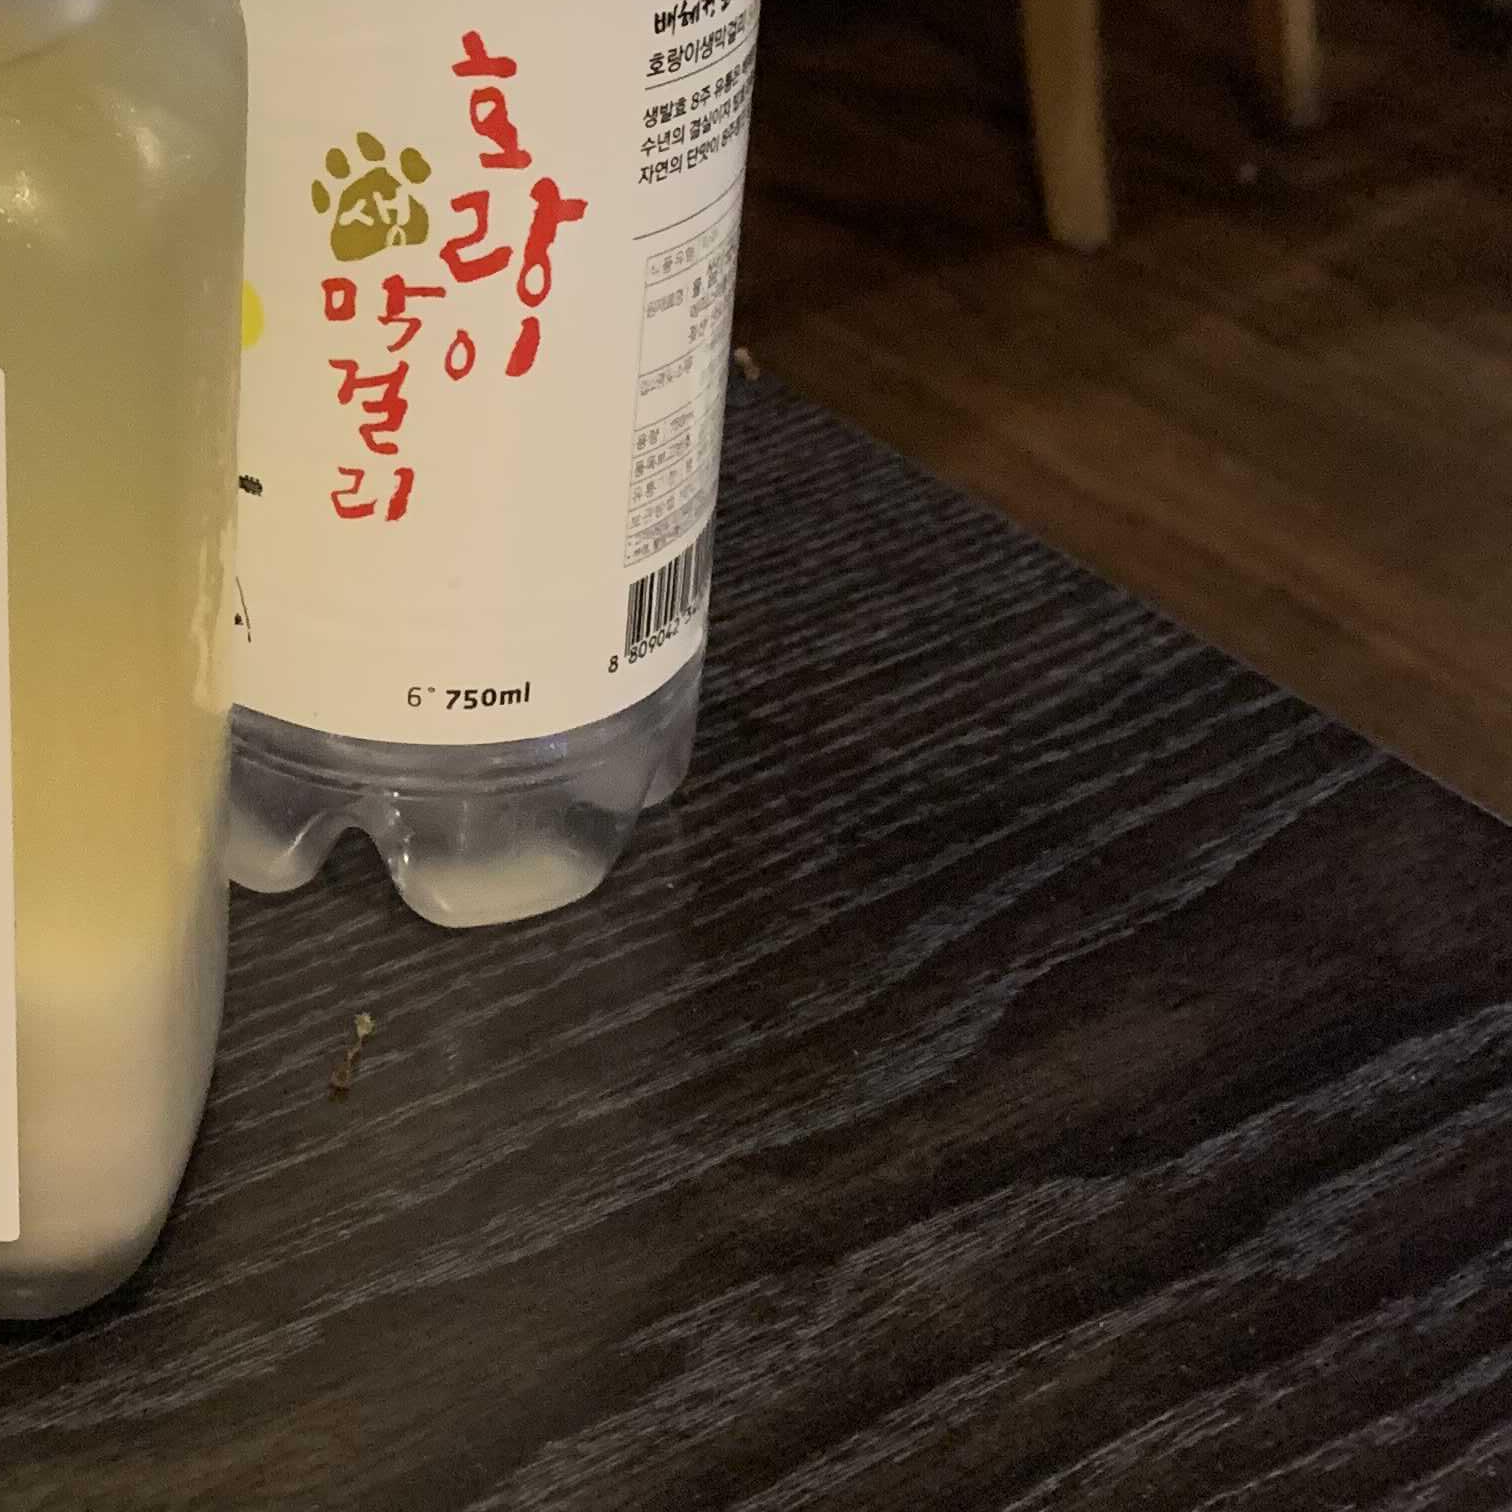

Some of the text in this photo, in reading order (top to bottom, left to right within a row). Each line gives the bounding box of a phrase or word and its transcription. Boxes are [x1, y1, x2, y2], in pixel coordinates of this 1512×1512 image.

[439, 29, 589, 378] 호랑이
[321, 274, 447, 523] 막걸리
[445, 680, 531, 710] 750ml
